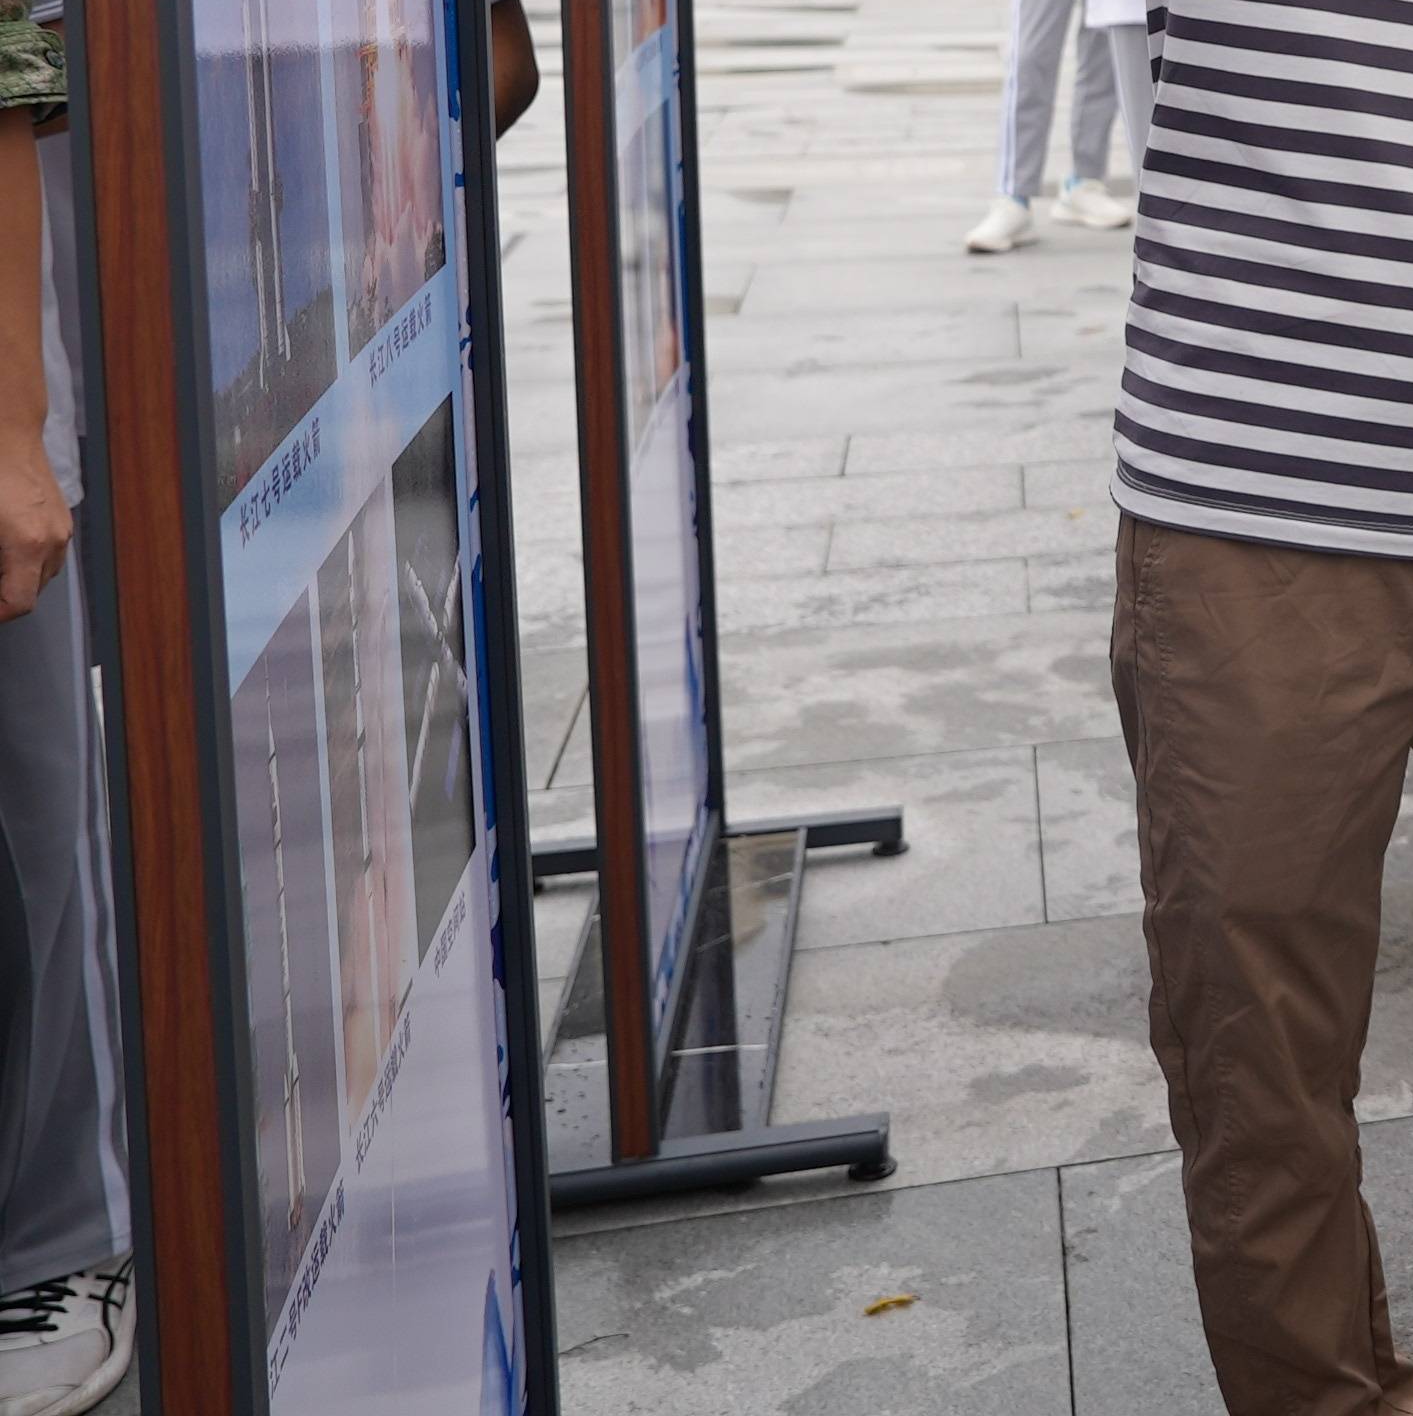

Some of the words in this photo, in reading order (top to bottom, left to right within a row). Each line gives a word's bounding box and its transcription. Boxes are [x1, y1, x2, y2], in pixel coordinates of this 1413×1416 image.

[239, 416, 321, 552] 长江七号运载火箭
